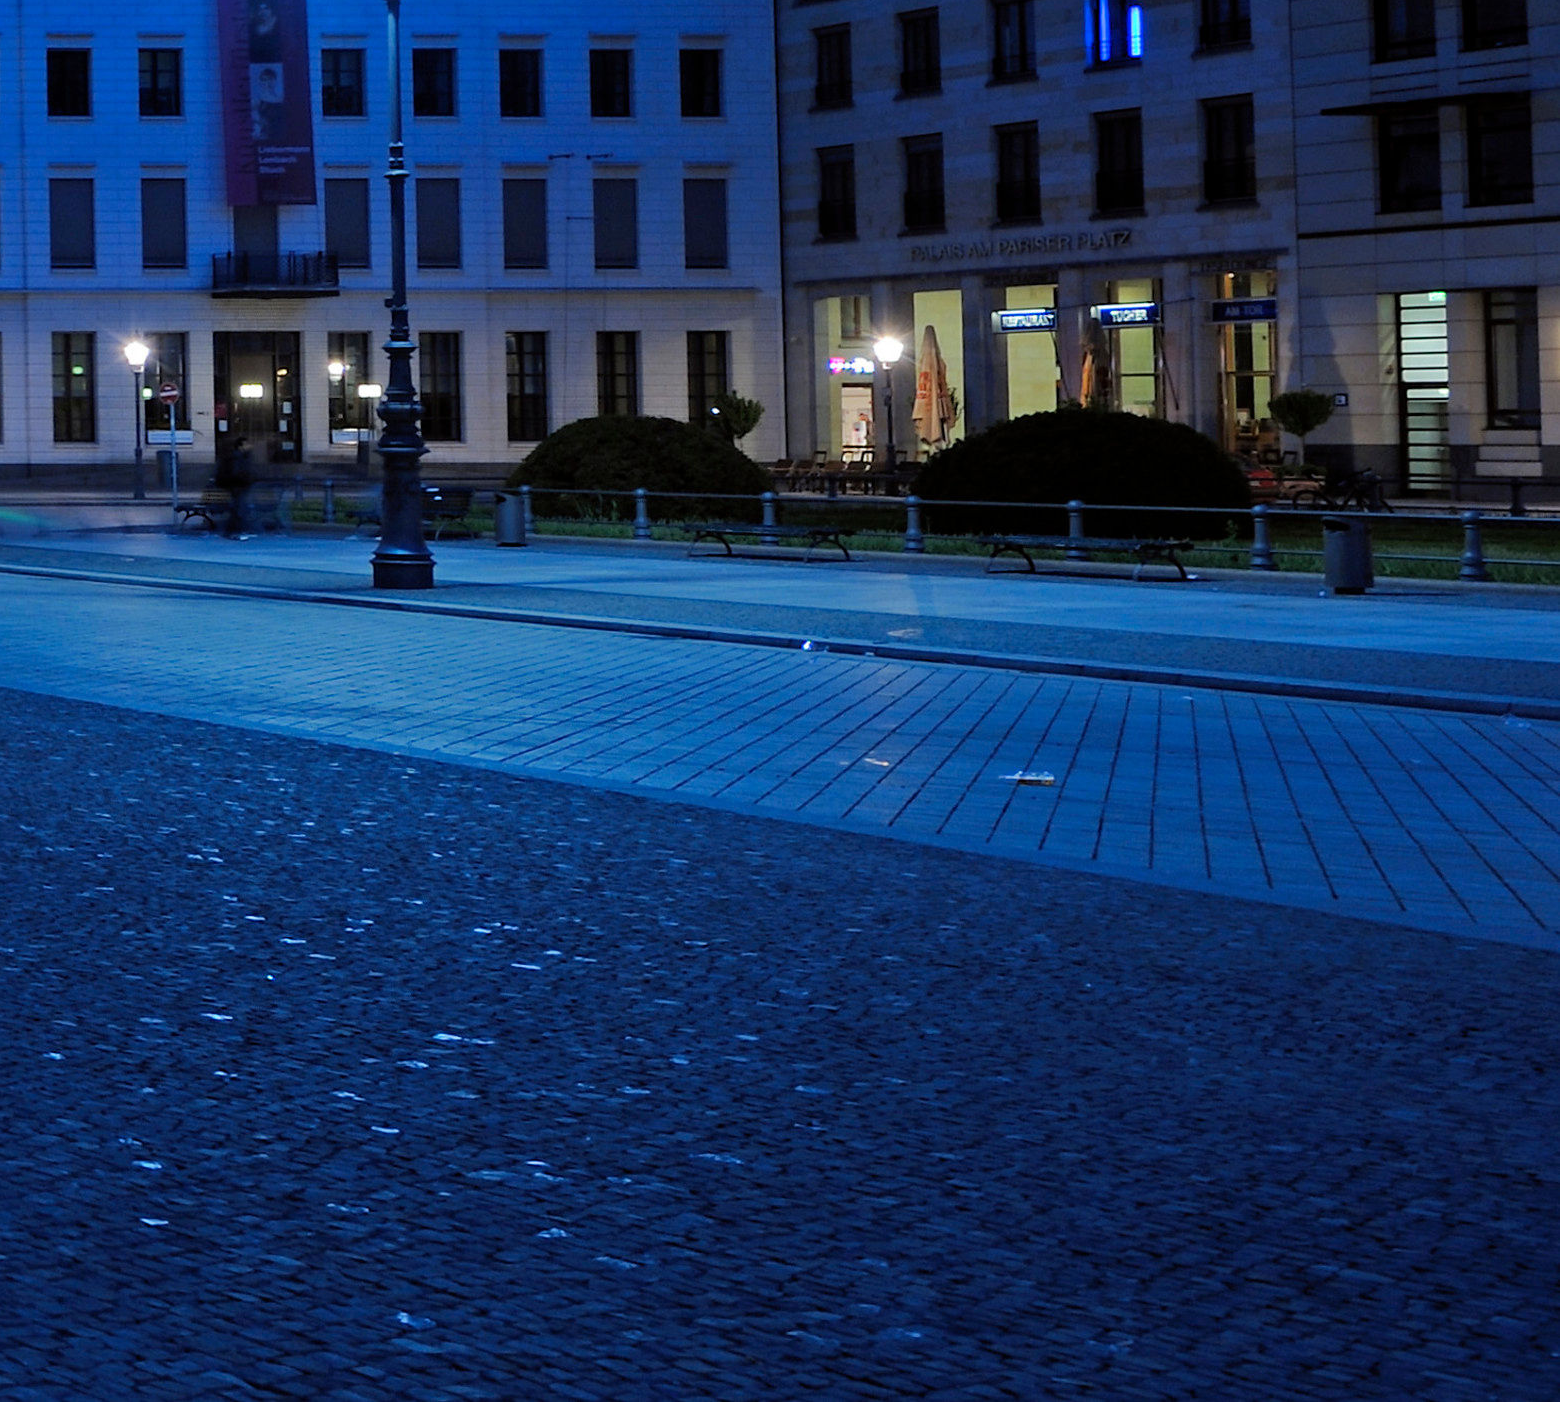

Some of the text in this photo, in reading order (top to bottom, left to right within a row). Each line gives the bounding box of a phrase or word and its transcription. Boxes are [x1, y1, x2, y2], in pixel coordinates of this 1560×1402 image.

[910, 229, 1132, 262] PALAIS AM PARISER PLATZ
